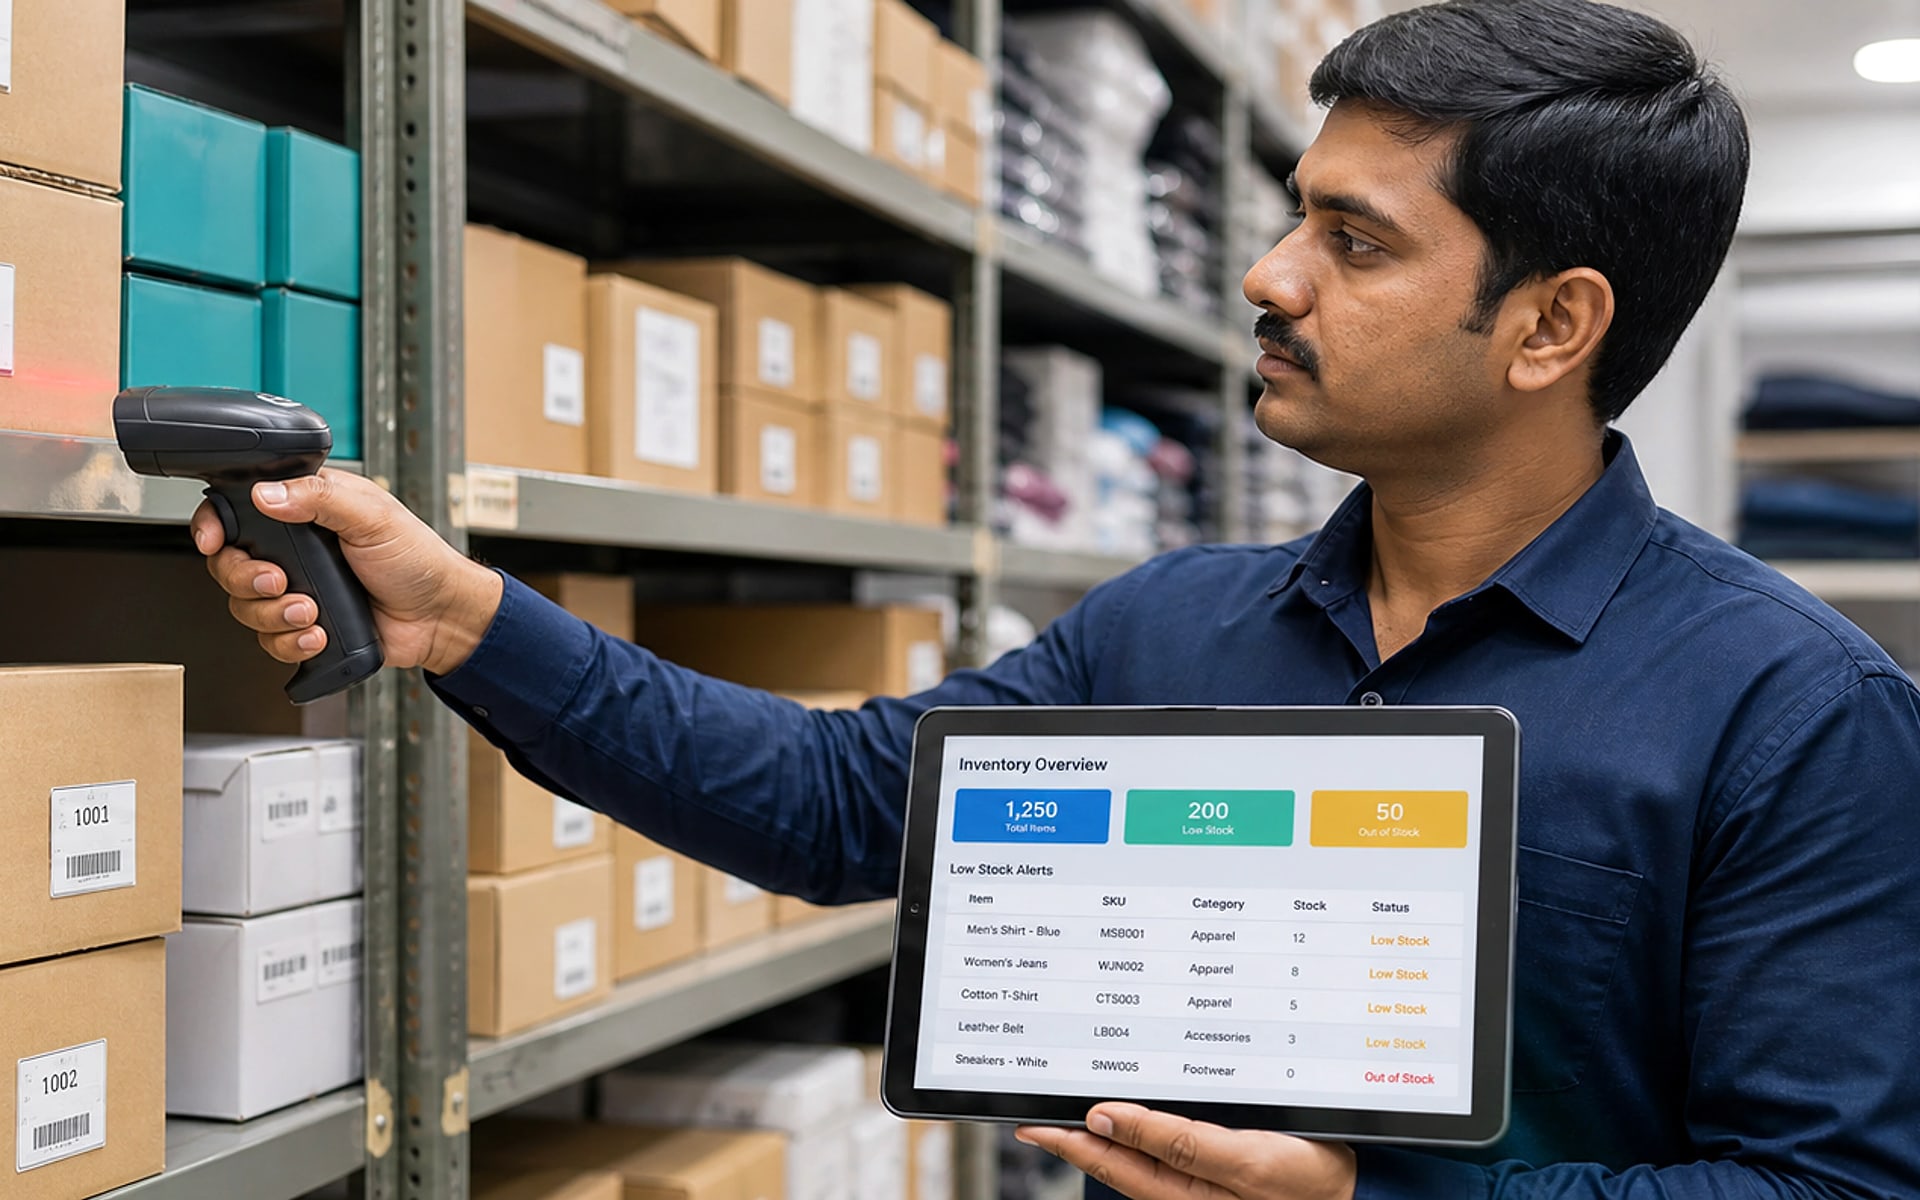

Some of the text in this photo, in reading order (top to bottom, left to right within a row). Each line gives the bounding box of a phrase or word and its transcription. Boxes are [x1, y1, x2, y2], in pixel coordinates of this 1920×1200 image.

[960, 757, 1107, 774] Inventory Overview
[74, 805, 109, 826] 1001
[1006, 801, 1057, 821] 1,250
[1188, 802, 1228, 819] 200
[1377, 803, 1403, 820] 50
[1206, 825, 1234, 835] Stock
[1392, 828, 1420, 836] Stock
[950, 864, 1053, 876] Low Stock Alerts
[969, 894, 993, 904] Item
[1103, 896, 1126, 906] SKU
[1192, 898, 1244, 911] Category
[1294, 900, 1326, 910] Stock
[1372, 902, 1409, 913] Status
[967, 925, 998, 934] Men's
[1001, 925, 1025, 935] Shirt
[1037, 926, 1060, 936] Blue
[1191, 930, 1235, 943] Apparel
[1294, 933, 1305, 943] 12
[1371, 935, 1429, 946] Low Stock
[964, 957, 1047, 969] Women's Jeans
[1098, 961, 1144, 972] WJN002
[1189, 964, 1233, 976] Apparel
[1291, 966, 1299, 977] 8
[1369, 969, 1428, 980] Low Stock
[961, 989, 1038, 1001] Cotton T-Shirt
[1096, 993, 1140, 1005] CTS003
[1187, 997, 1232, 1009] Apparel
[1290, 1000, 1297, 1010] 5
[1368, 1003, 1427, 1014] Low Stock
[959, 1022, 1023, 1034] Leather Belt
[1094, 1026, 1129, 1037] LB004
[1184, 1031, 1251, 1043] Accessories
[1288, 1034, 1296, 1044] 3
[1366, 1037, 1426, 1049] Low Stock
[956, 1054, 1005, 1066] Sneakers
[1016, 1057, 1047, 1067] White
[1183, 1064, 1235, 1076] Footwear
[1287, 1068, 1294, 1078] 0
[42, 1069, 78, 1095] 1002
[1365, 1072, 1434, 1084] Out of Stock
